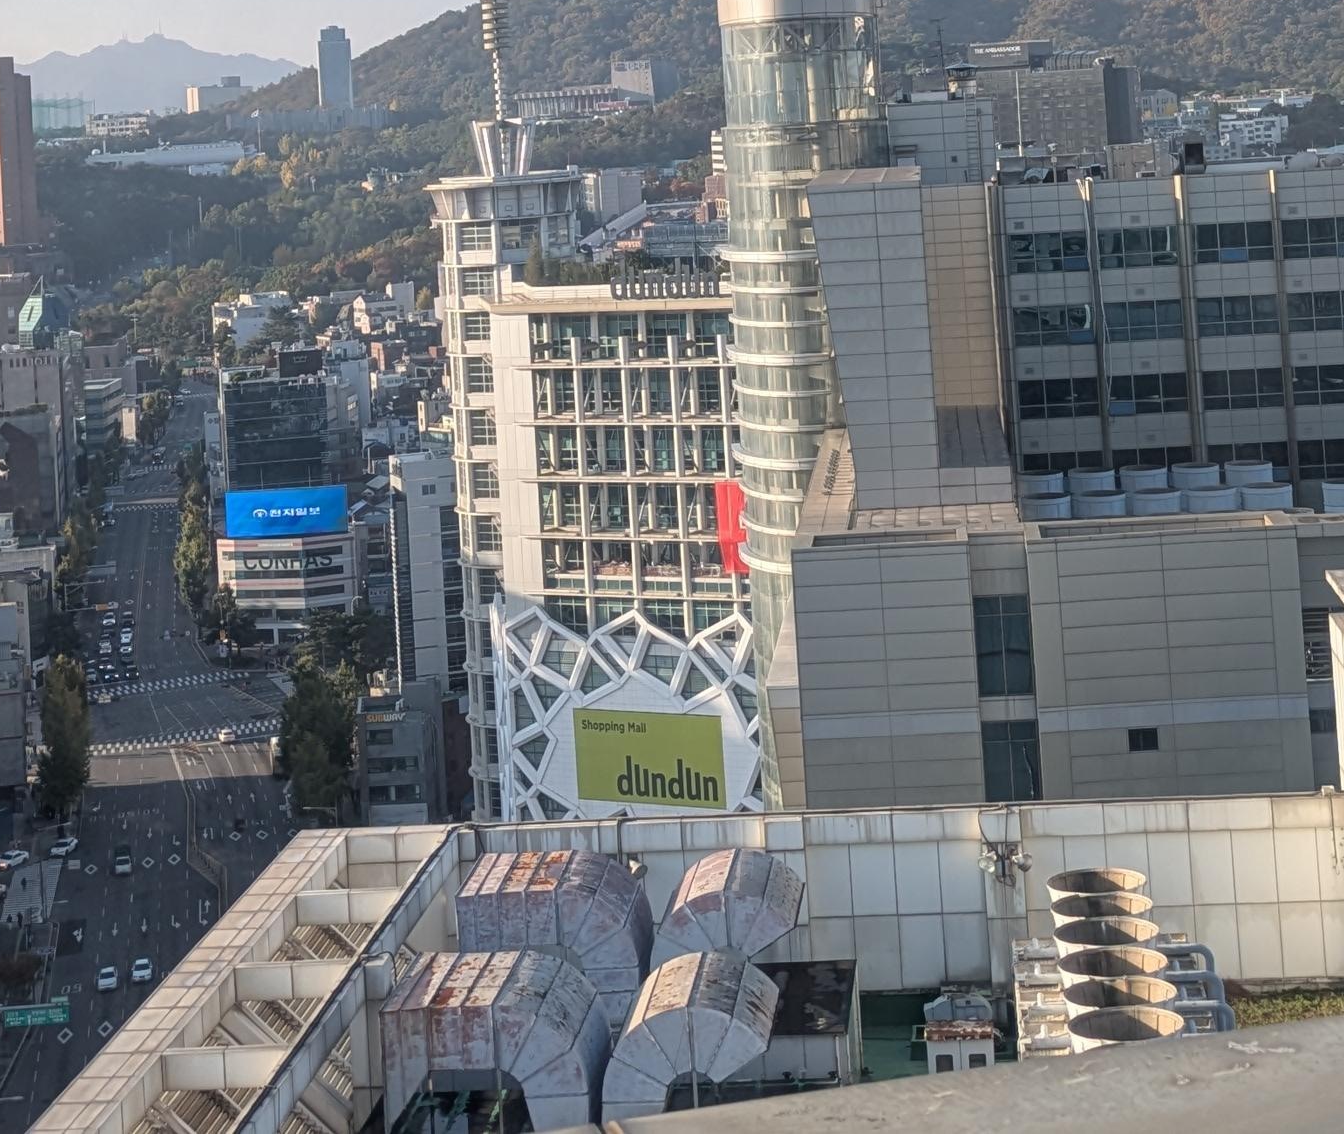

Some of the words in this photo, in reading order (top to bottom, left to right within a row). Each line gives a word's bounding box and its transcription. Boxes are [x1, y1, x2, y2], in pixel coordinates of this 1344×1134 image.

[581, 719, 625, 734] Shopping
[627, 722, 647, 733] Mall
[617, 755, 719, 802] dundun
